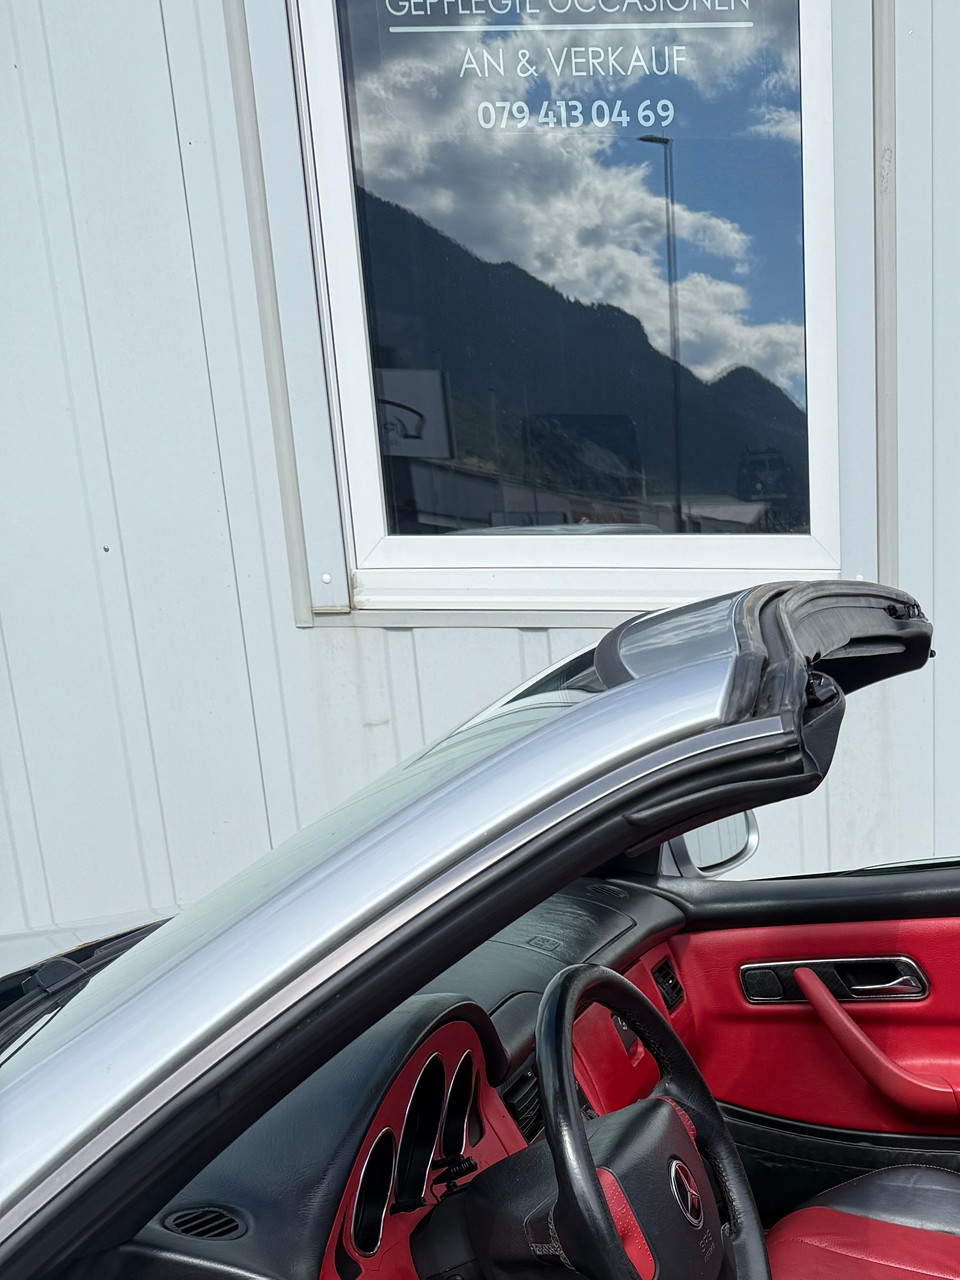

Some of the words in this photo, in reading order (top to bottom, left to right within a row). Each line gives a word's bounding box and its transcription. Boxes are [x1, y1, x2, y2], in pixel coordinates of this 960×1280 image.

[459, 48, 505, 78] AN
[516, 49, 538, 78] &
[546, 45, 687, 77] VERKAUF
[477, 101, 530, 129] 079
[537, 100, 584, 128] 413
[591, 100, 631, 127] 04
[637, 99, 675, 127] 69
